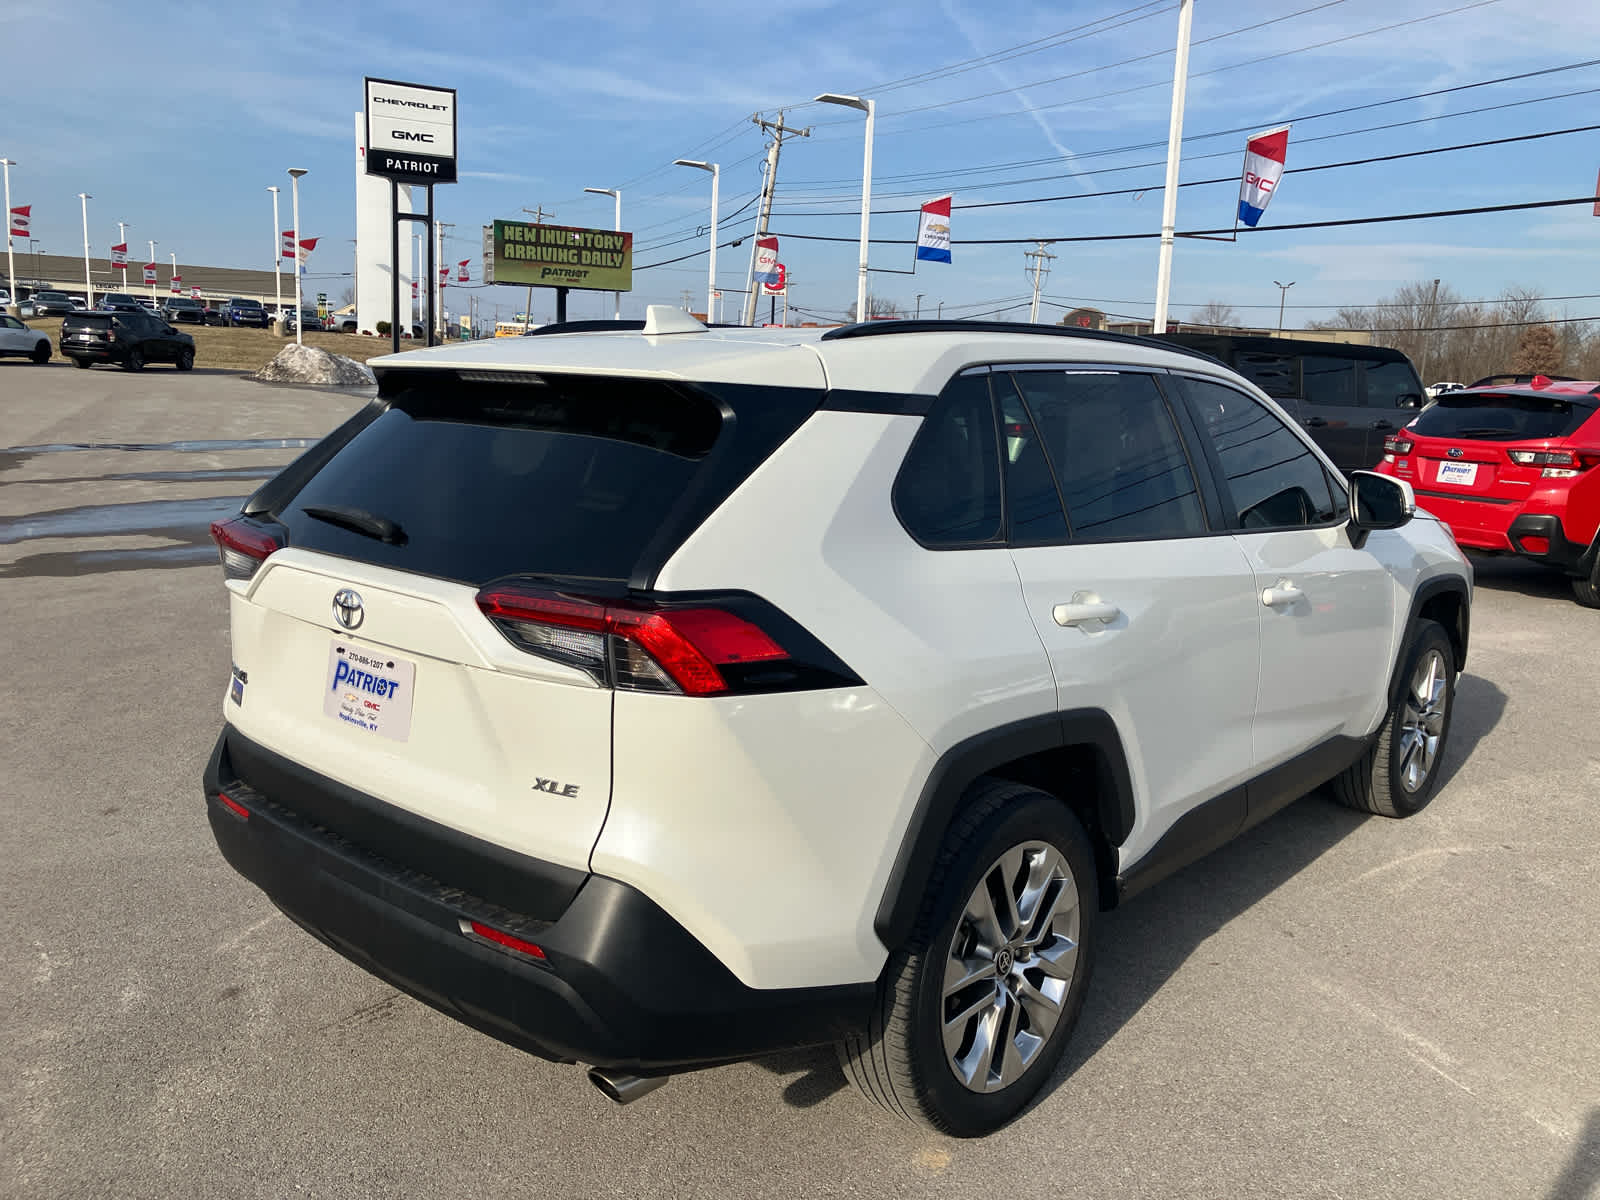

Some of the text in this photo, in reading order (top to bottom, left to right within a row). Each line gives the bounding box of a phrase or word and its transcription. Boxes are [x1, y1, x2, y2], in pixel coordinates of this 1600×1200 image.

[373, 96, 448, 111] CHEVROLET
[392, 130, 434, 143] GMC
[386, 158, 439, 173] PATRIOT
[504, 225, 624, 250] NEW INVENTORY
[504, 243, 624, 267] ARRIVING DAILY
[759, 257, 777, 265] GM
[541, 267, 590, 279] PATRIOT
[1442, 465, 1472, 475] PATRIOT
[332, 658, 399, 699] PATRIOT
[364, 700, 380, 712] GMC
[369, 723, 378, 731] KY
[531, 777, 580, 798] XLE
